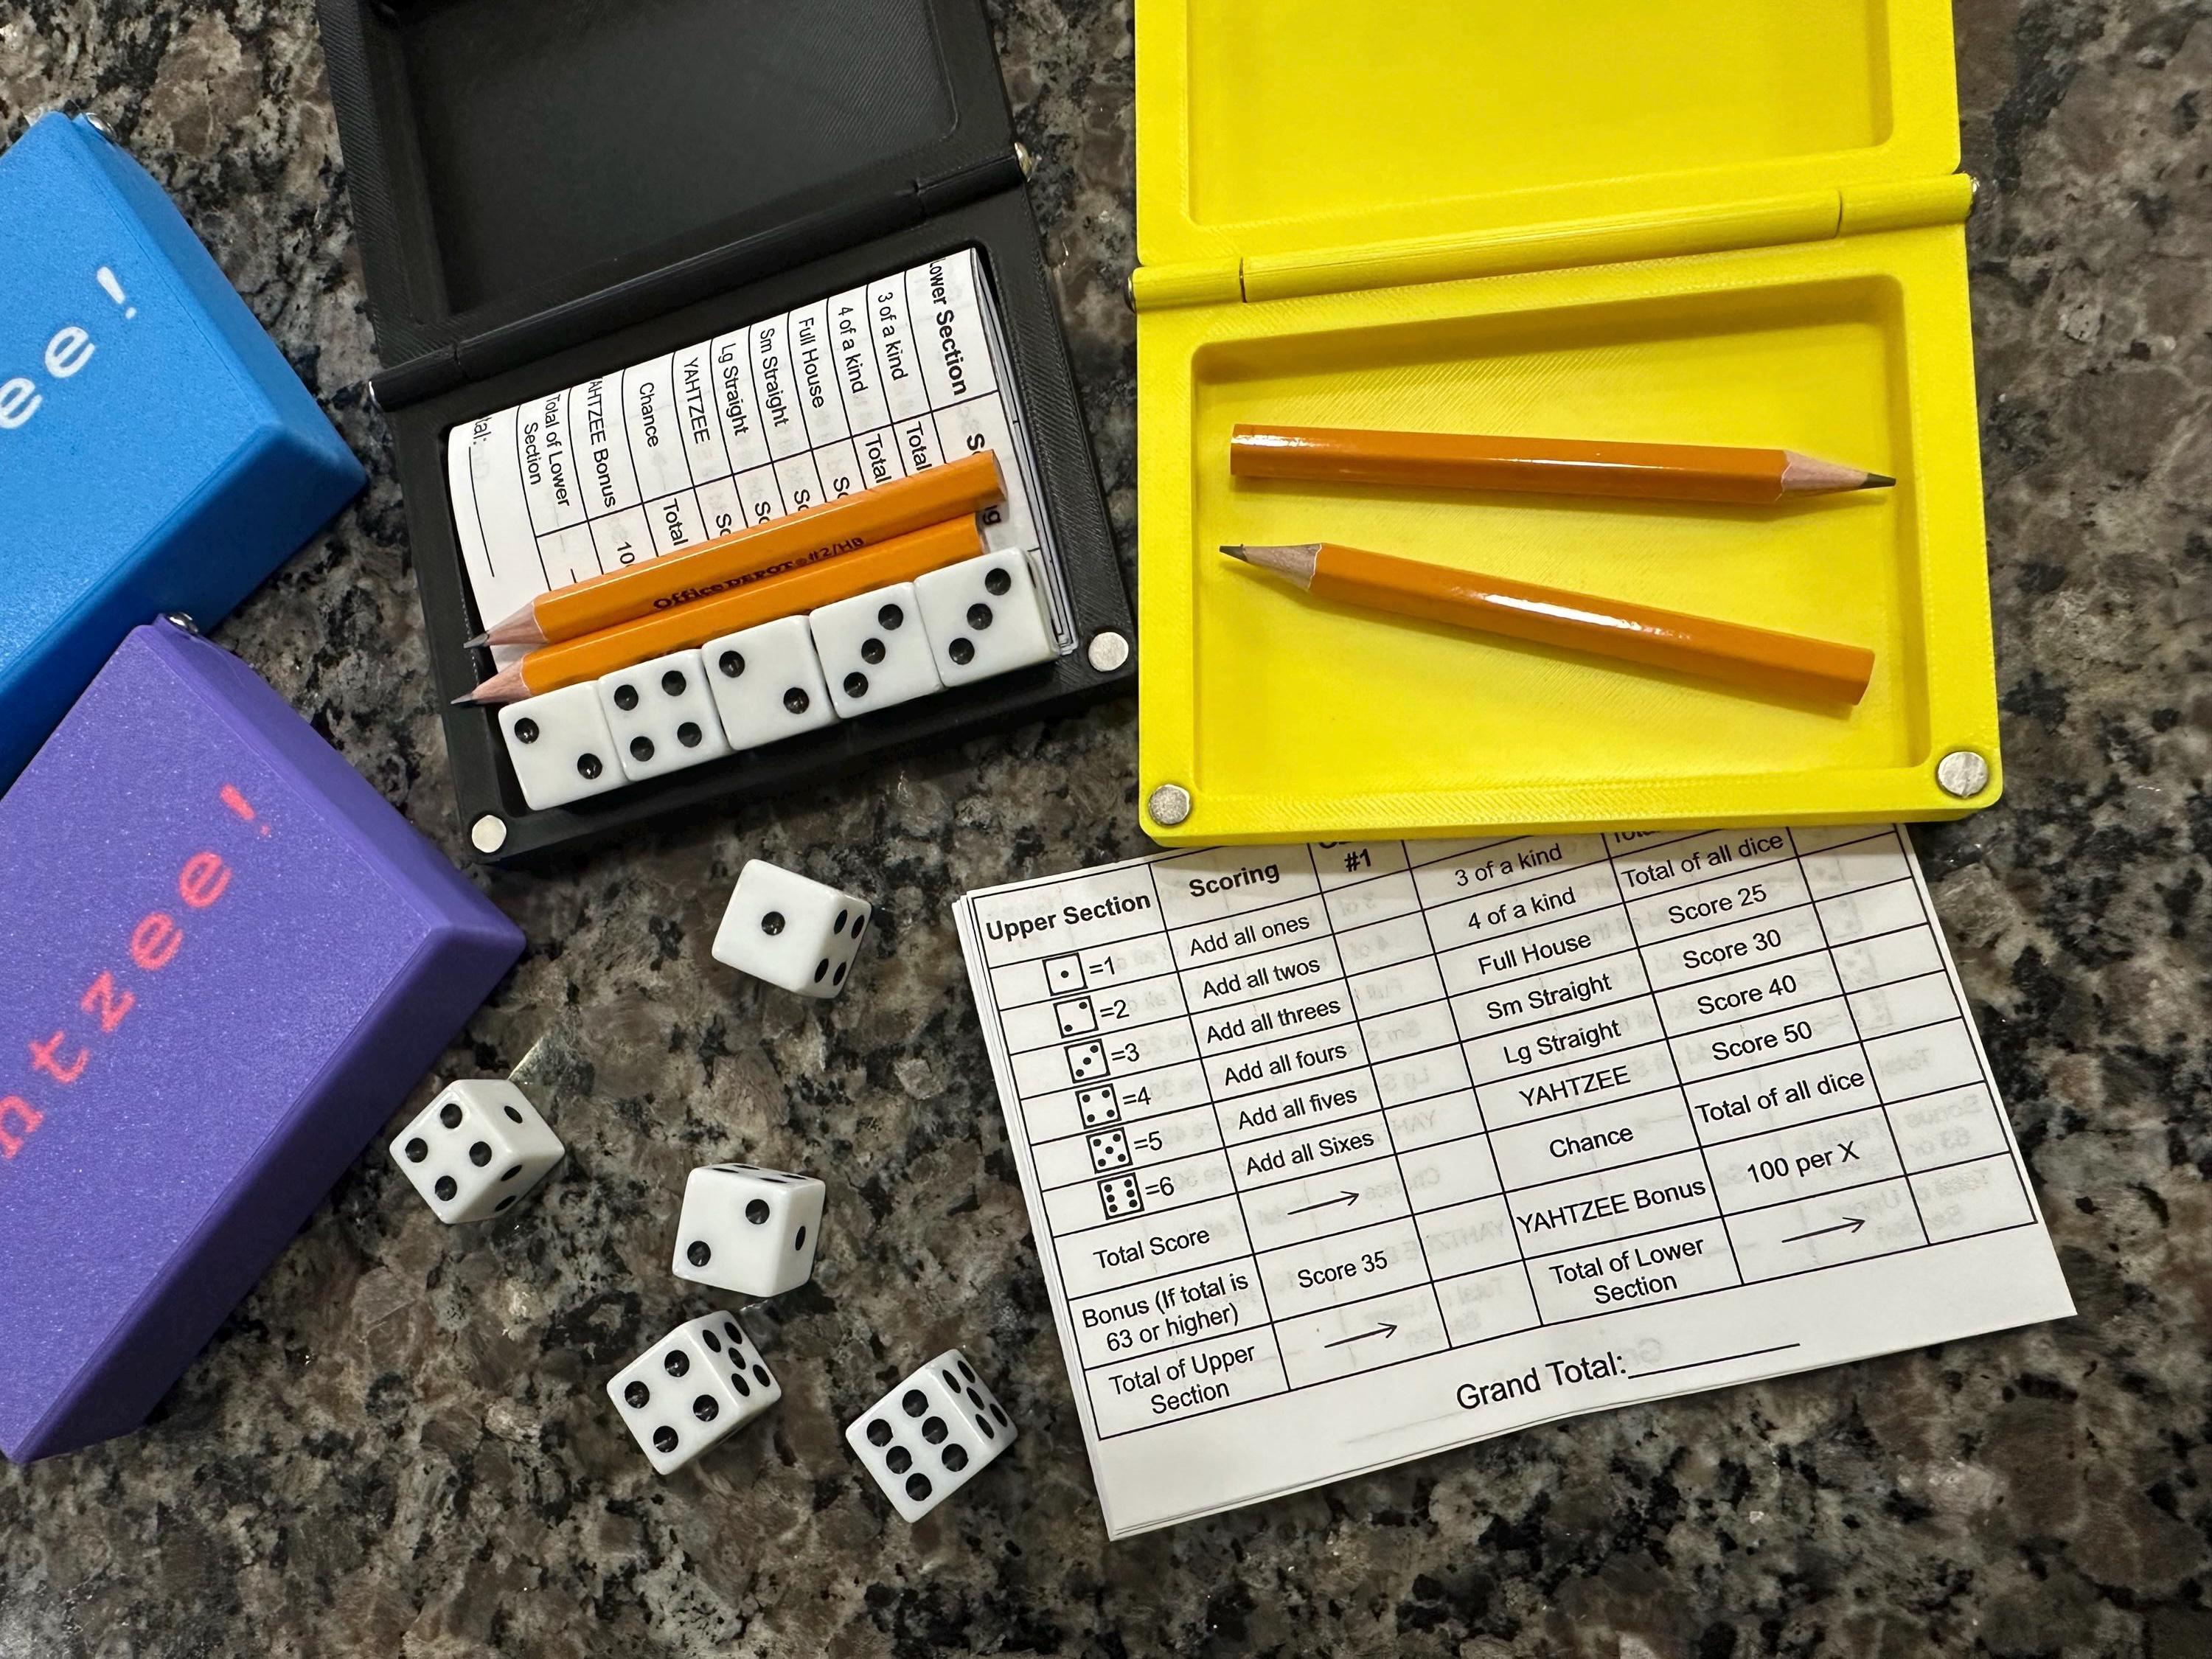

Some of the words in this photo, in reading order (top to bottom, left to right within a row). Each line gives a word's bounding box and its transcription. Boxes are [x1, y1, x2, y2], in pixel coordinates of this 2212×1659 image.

[838, 307, 855, 316] 4
[877, 291, 894, 303] 3
[879, 306, 897, 322] of
[759, 327, 776, 354] Sm
[798, 316, 816, 347] Full
[839, 319, 857, 335] of
[842, 338, 855, 352] a
[882, 324, 895, 338] a
[717, 342, 737, 364] Lg
[845, 352, 869, 394] kind
[885, 339, 909, 381] kind
[936, 309, 967, 396] Section
[762, 355, 790, 428] Straight
[801, 347, 824, 409] House
[544, 393, 560, 425] Total
[587, 377, 607, 446] AHTZEE
[639, 382, 659, 448] Chance
[684, 356, 711, 445] YAHTZEE
[723, 365, 749, 437] Straight
[524, 422, 542, 485] Section
[546, 431, 563, 448] of
[865, 433, 892, 484] Total
[906, 420, 933, 471] Total
[548, 450, 570, 507] Lower
[593, 448, 616, 508] Bonus
[663, 497, 689, 546] Total
[616, 540, 636, 566] 10
[1189, 863, 1280, 897] Scoring
[1343, 848, 1371, 873] #1
[1455, 869, 1469, 887] 3
[1475, 860, 1495, 882] of
[1500, 860, 1514, 874] a
[1517, 842, 1563, 870] kind
[1620, 859, 1675, 888] Total
[1680, 851, 1701, 873] of
[1706, 844, 1733, 866] all
[1738, 835, 1784, 858] dice
[985, 914, 1057, 942] Upper
[1062, 894, 1151, 925] Section
[1468, 911, 1481, 930] 4
[1487, 903, 1507, 925] of
[1512, 904, 1528, 919] a
[1530, 886, 1576, 914] kind
[1668, 897, 1733, 924] Score
[1737, 883, 1767, 907] 25
[1190, 931, 1229, 957] Add
[1234, 925, 1257, 946] all
[1262, 916, 1310, 939] ones
[1478, 949, 1517, 975] Full
[1521, 934, 1592, 964] House
[1683, 942, 1748, 969] Score
[1752, 929, 1781, 951] 30
[1203, 973, 1242, 999] Add
[1246, 967, 1270, 988] all
[1273, 959, 1321, 982] twos
[1486, 999, 1523, 1020] Sm
[1527, 973, 1613, 1009] Straight
[1697, 988, 1764, 1015] Score
[1768, 975, 1797, 996] 40
[1207, 1018, 1246, 1044] Add
[1251, 1012, 1274, 1033] all
[1277, 1000, 1341, 1027] threes
[1503, 1045, 1532, 1065] Lg
[1536, 1019, 1622, 1056] Straight
[1711, 1034, 1778, 1061] Score
[1783, 1020, 1812, 1043] 50
[1225, 1060, 1264, 1087] Add
[1268, 1053, 1293, 1075] all
[1295, 1045, 1348, 1069] fours
[1518, 1065, 1632, 1107] YAHTZEE
[1239, 1104, 1279, 1130] Add
[1282, 1096, 1307, 1119] all
[1309, 1089, 1357, 1113] fives
[1694, 1094, 1752, 1123] Total
[1757, 1087, 1778, 1110] of
[1784, 1079, 1812, 1103] all
[1817, 1072, 1865, 1096] dice
[1247, 1149, 1286, 1176] Add
[1290, 1142, 1315, 1164] all
[1318, 1133, 1374, 1158] Sixes
[1549, 1127, 1634, 1158] Chance
[1747, 1157, 1790, 1183] 100
[1795, 1150, 1834, 1178] per
[1836, 1140, 1860, 1163] X
[1516, 1193, 1630, 1234] YAHTZEE
[1632, 1180, 1706, 1209] Bonus
[1092, 1240, 1145, 1269] Total
[1149, 1230, 1210, 1256] Score
[1297, 1262, 1357, 1289] Score
[1361, 1250, 1388, 1273] 35
[1548, 1256, 1604, 1284] Total
[1609, 1250, 1630, 1273] of
[1634, 1239, 1704, 1281] Lower
[1082, 1300, 1150, 1329] Bonus
[1155, 1287, 1182, 1319] (If
[1180, 1276, 1227, 1304] total
[1228, 1273, 1249, 1292] is
[1593, 1275, 1678, 1304] Section
[1106, 1329, 1133, 1352] 63
[1138, 1325, 1161, 1343] or
[1164, 1301, 1239, 1338] higher)
[1107, 1365, 1161, 1395] Total
[1166, 1357, 1186, 1381] of
[1191, 1346, 1255, 1388] Upper
[1456, 1366, 1542, 1410] Grand
[1545, 1351, 1627, 1386] Total:
[1150, 1382, 1231, 1414] Section
